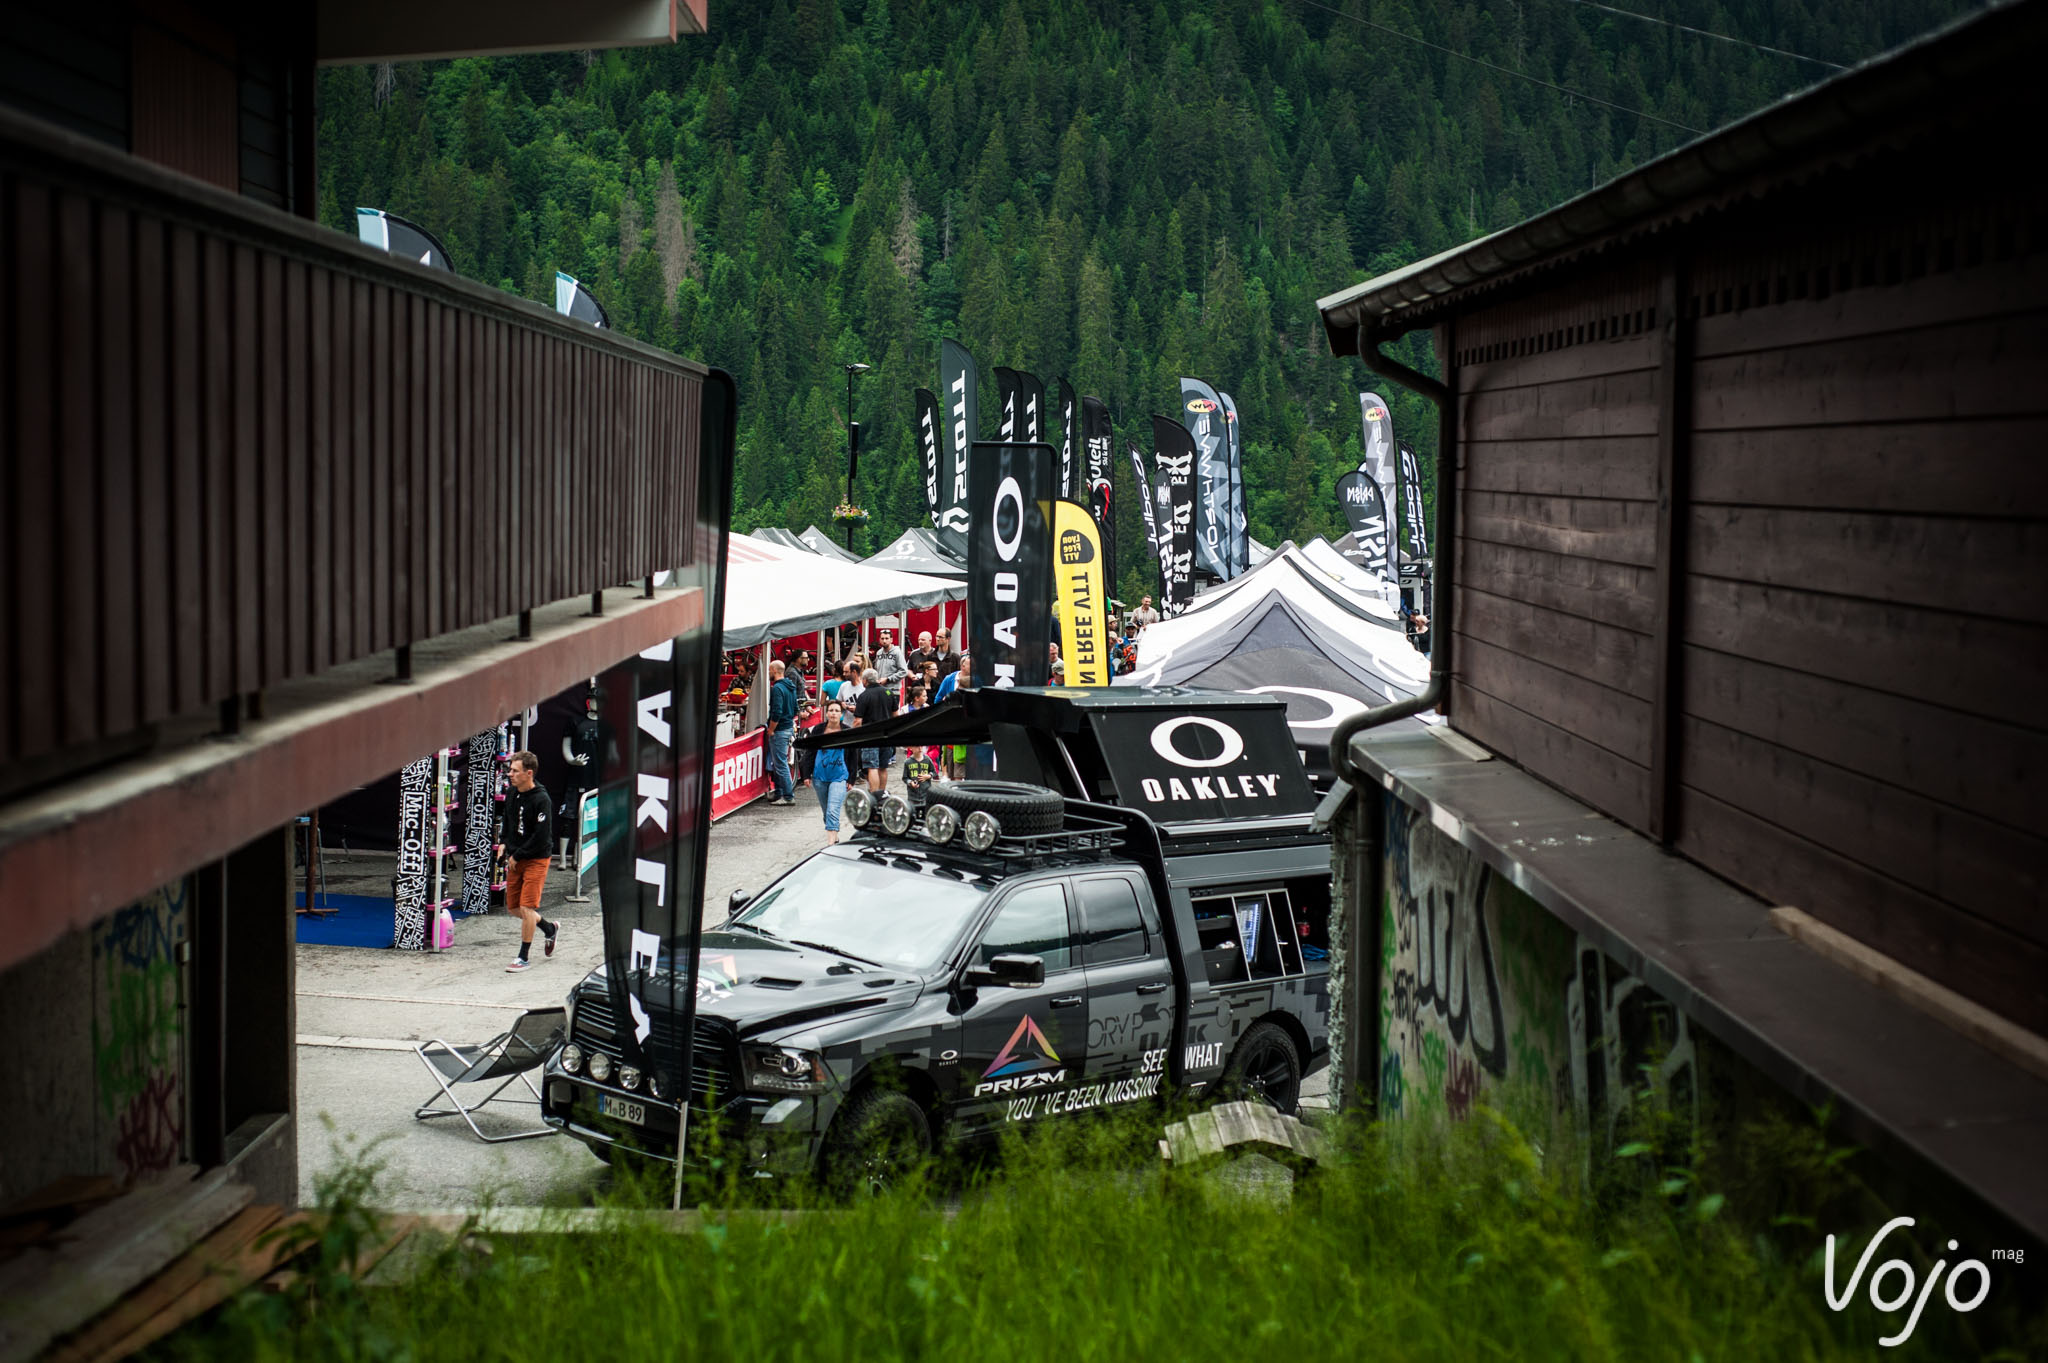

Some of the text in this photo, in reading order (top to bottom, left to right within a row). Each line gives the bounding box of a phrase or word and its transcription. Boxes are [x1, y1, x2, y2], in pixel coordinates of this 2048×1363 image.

[1406, 485, 1421, 554] Julbo
[713, 745, 763, 798] SRAM
[473, 773, 486, 828] Muc-Off
[1141, 774, 1280, 802] OAKLEY
[404, 795, 423, 873] Muc-Off
[1141, 1042, 1223, 1074] SEE WHAT
[974, 1069, 1066, 1097] PRIZM
[1064, 1084, 1102, 1112] BEEN
[628, 1104, 642, 1122] 89
